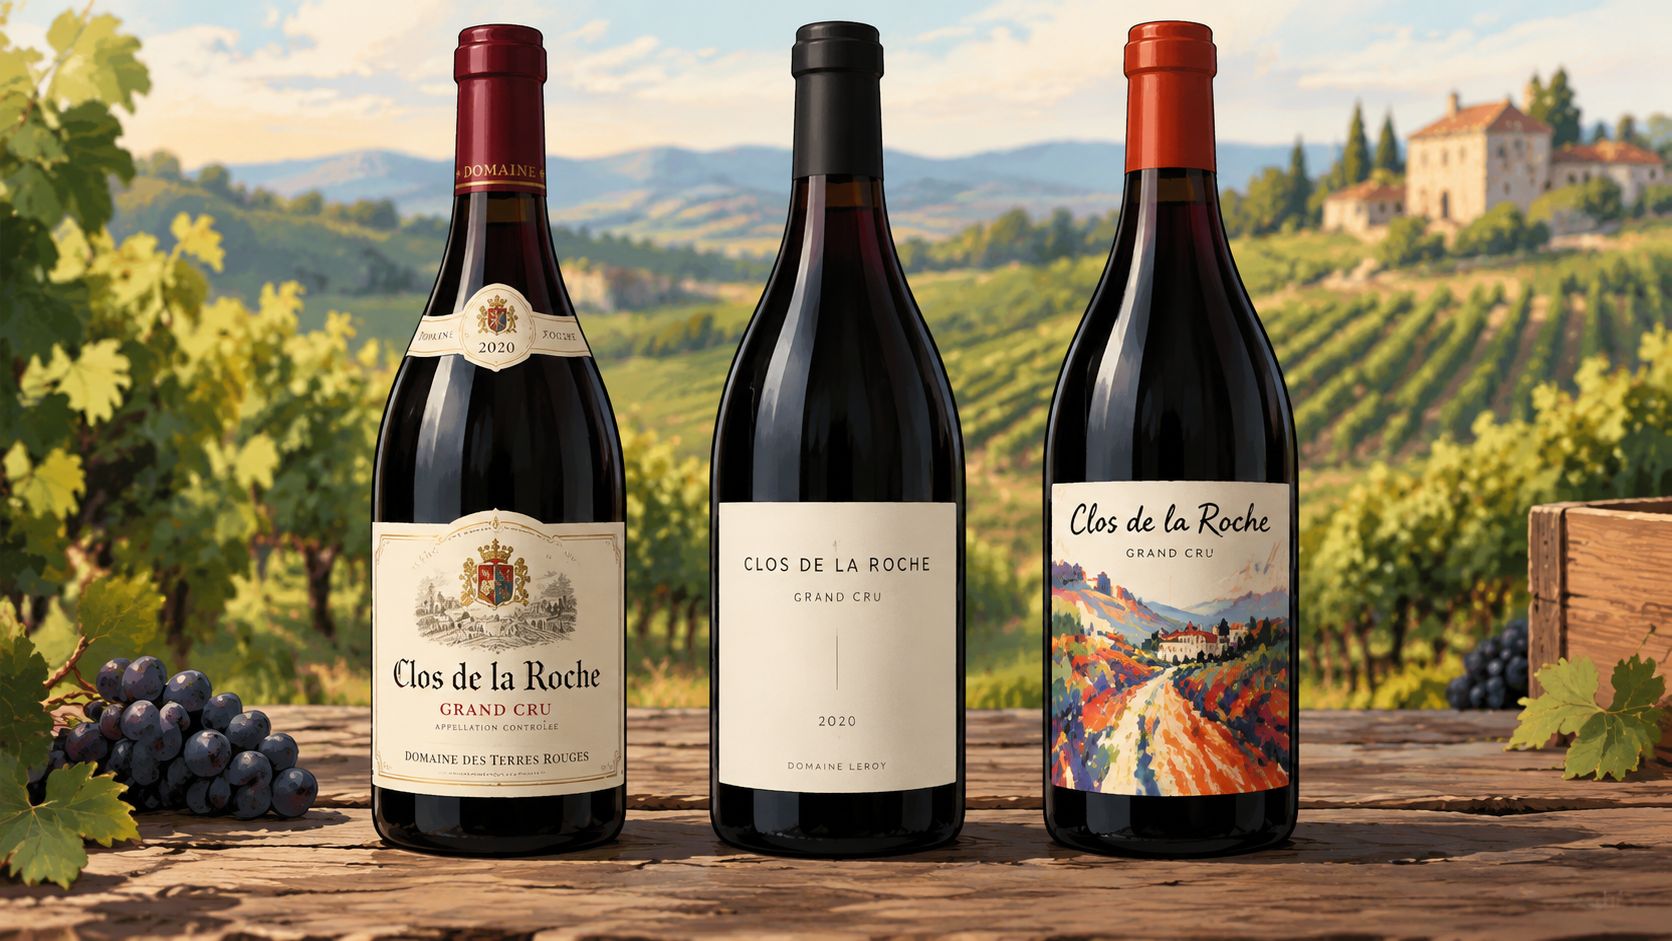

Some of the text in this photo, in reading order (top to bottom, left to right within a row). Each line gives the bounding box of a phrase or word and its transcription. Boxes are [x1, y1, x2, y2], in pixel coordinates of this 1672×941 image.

[464, 164, 536, 178] DOMAINE
[479, 342, 515, 353] 2020
[1070, 502, 1271, 538] Clos de la Roche
[1126, 548, 1214, 558] GRAND CRU
[744, 557, 930, 572] CLOS DE LA ROCHE
[794, 592, 882, 602] GRAND CRU
[393, 658, 601, 691] Clos de la Roche
[440, 703, 551, 716] GRAND CRU
[819, 716, 856, 726] 2020
[435, 723, 498, 732] APPELLATION
[405, 751, 590, 766] DOMAINE DES TERRES ROUGES
[788, 762, 887, 771] DOMAINE LEROY
